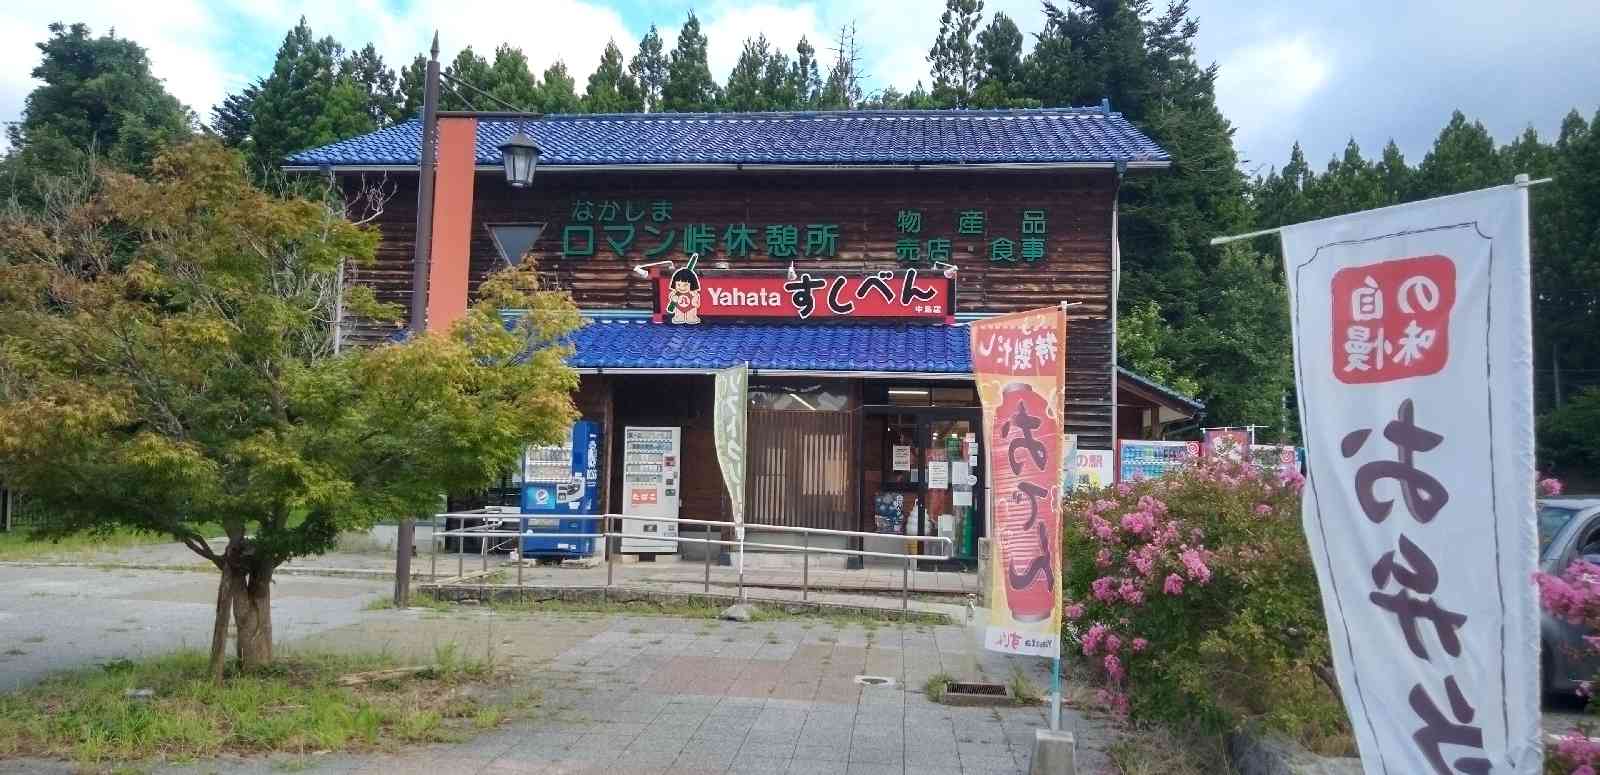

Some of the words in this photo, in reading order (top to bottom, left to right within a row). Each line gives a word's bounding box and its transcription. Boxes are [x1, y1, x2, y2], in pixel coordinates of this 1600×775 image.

[571, 200, 673, 222] なかしま
[561, 224, 840, 257] ロマン峠休憩所
[708, 287, 781, 306] Yahata
[784, 268, 938, 319] すしべん
